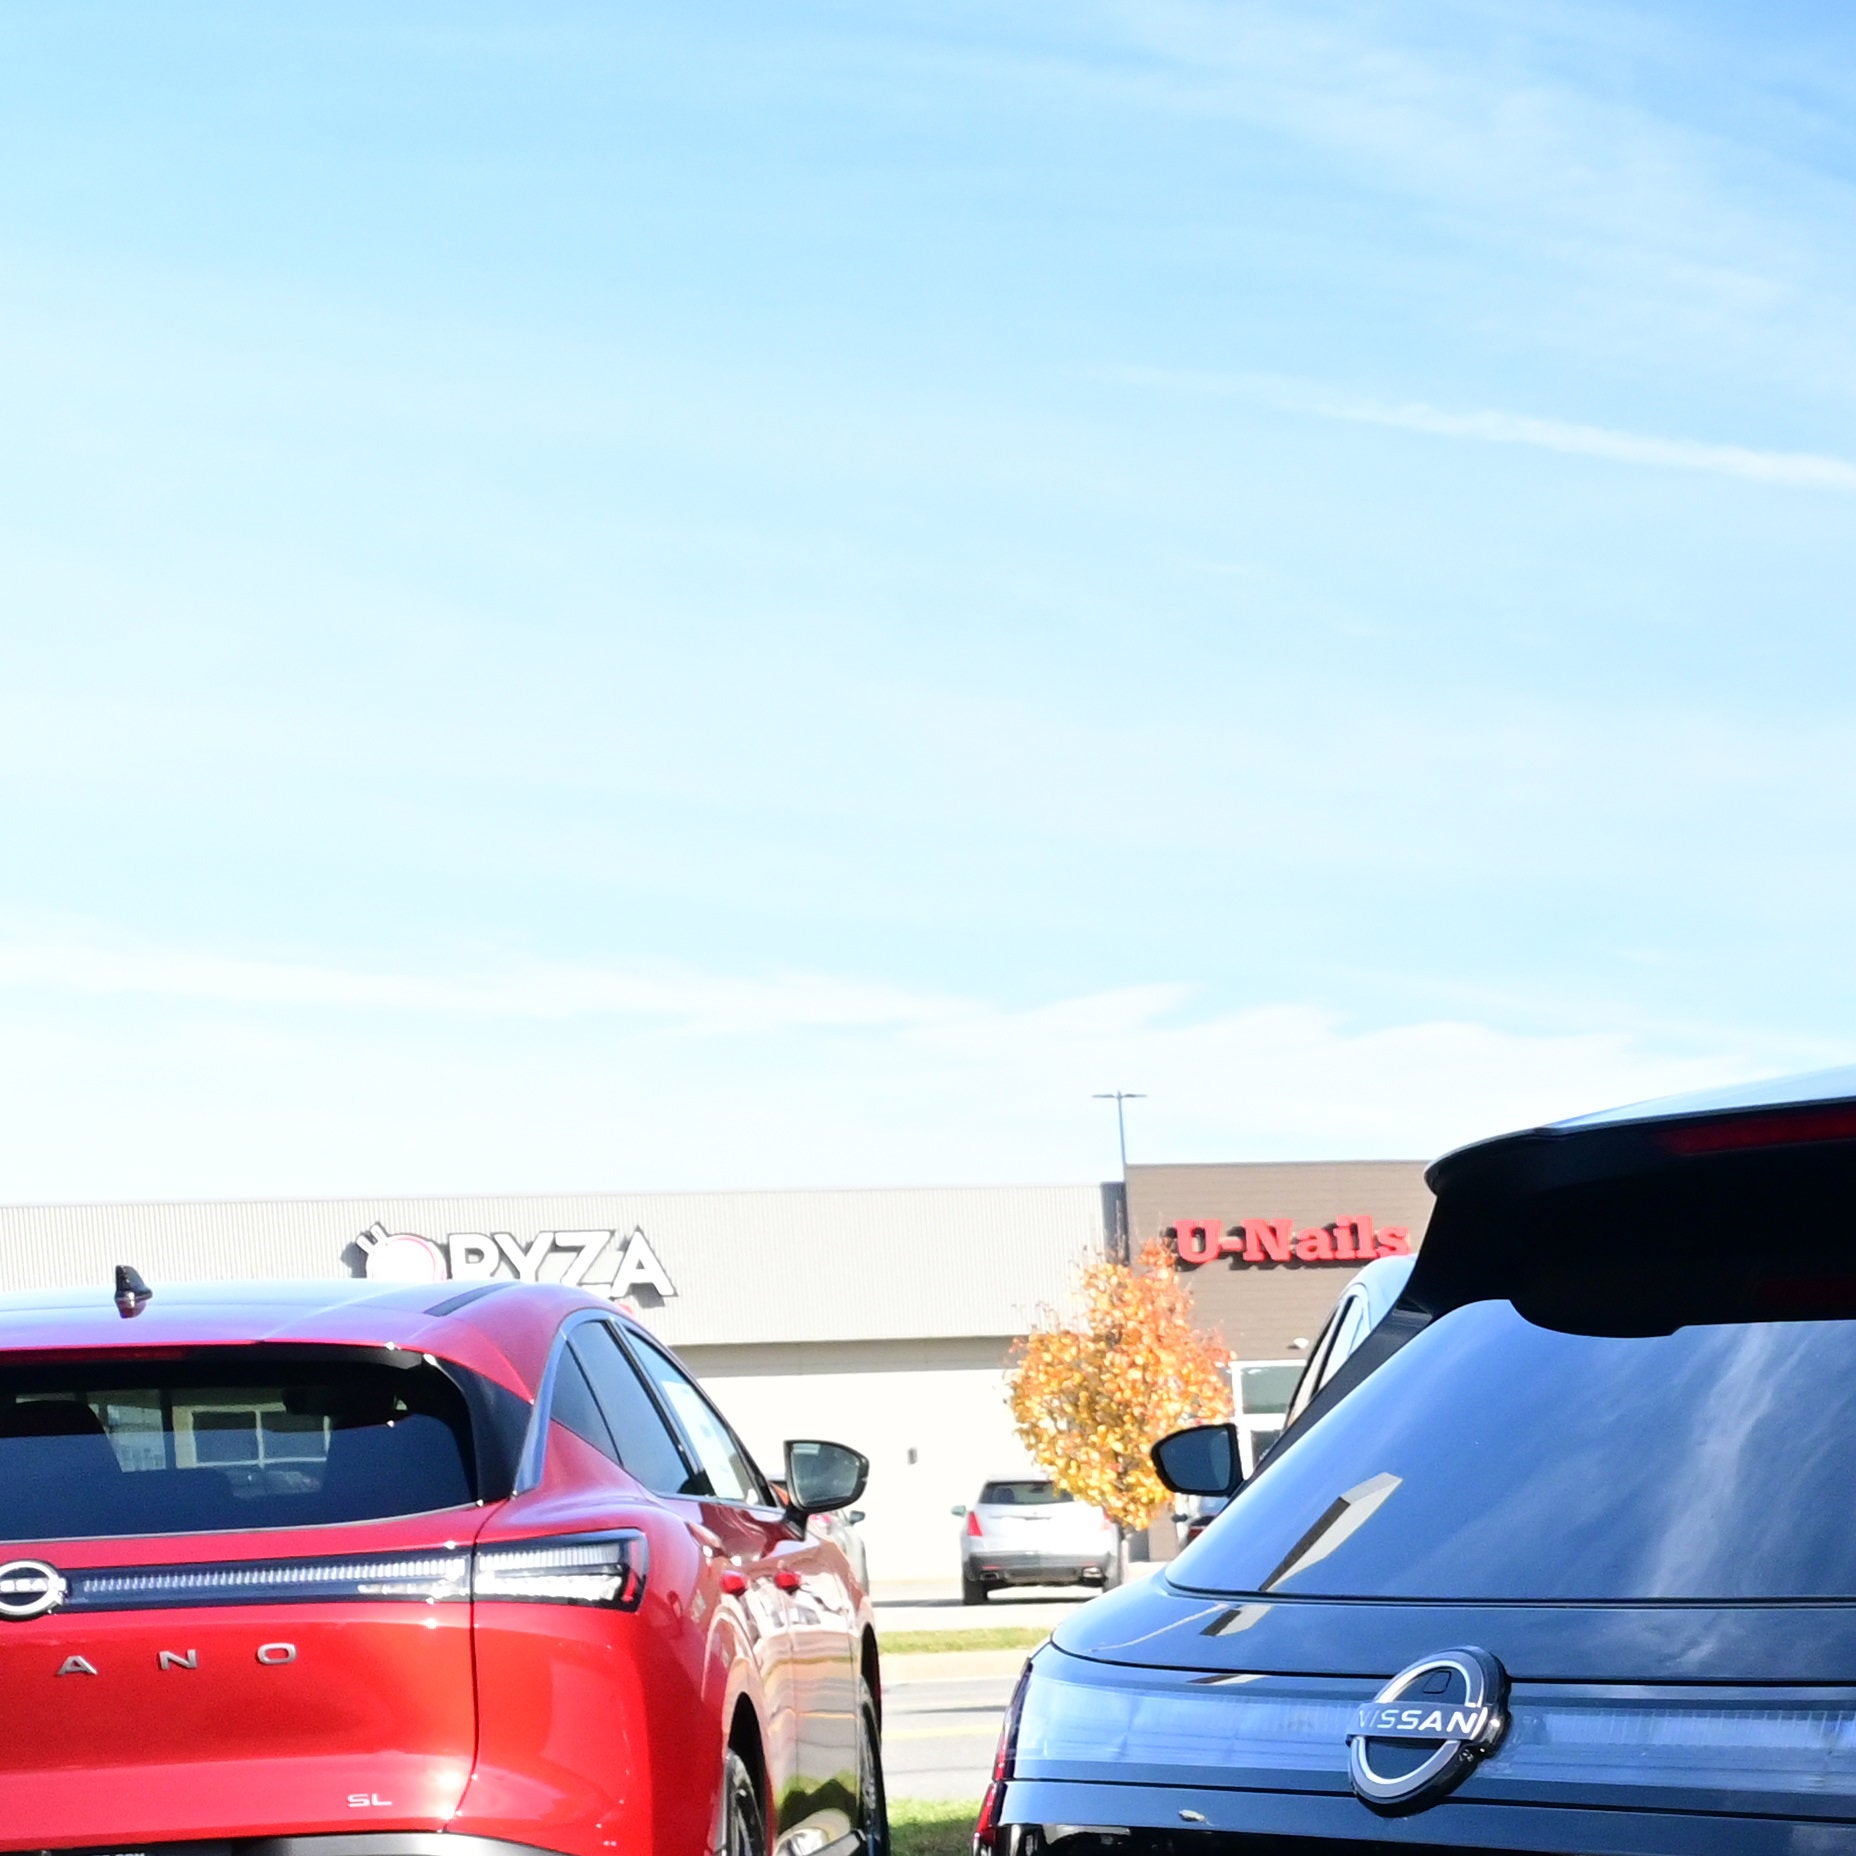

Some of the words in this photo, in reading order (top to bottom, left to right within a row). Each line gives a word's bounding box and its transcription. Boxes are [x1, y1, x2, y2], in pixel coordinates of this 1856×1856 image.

[1173, 1215, 1411, 1265] U-Nails
[1358, 1709, 1479, 1734] NISSAN
[347, 1793, 392, 1808] SL
